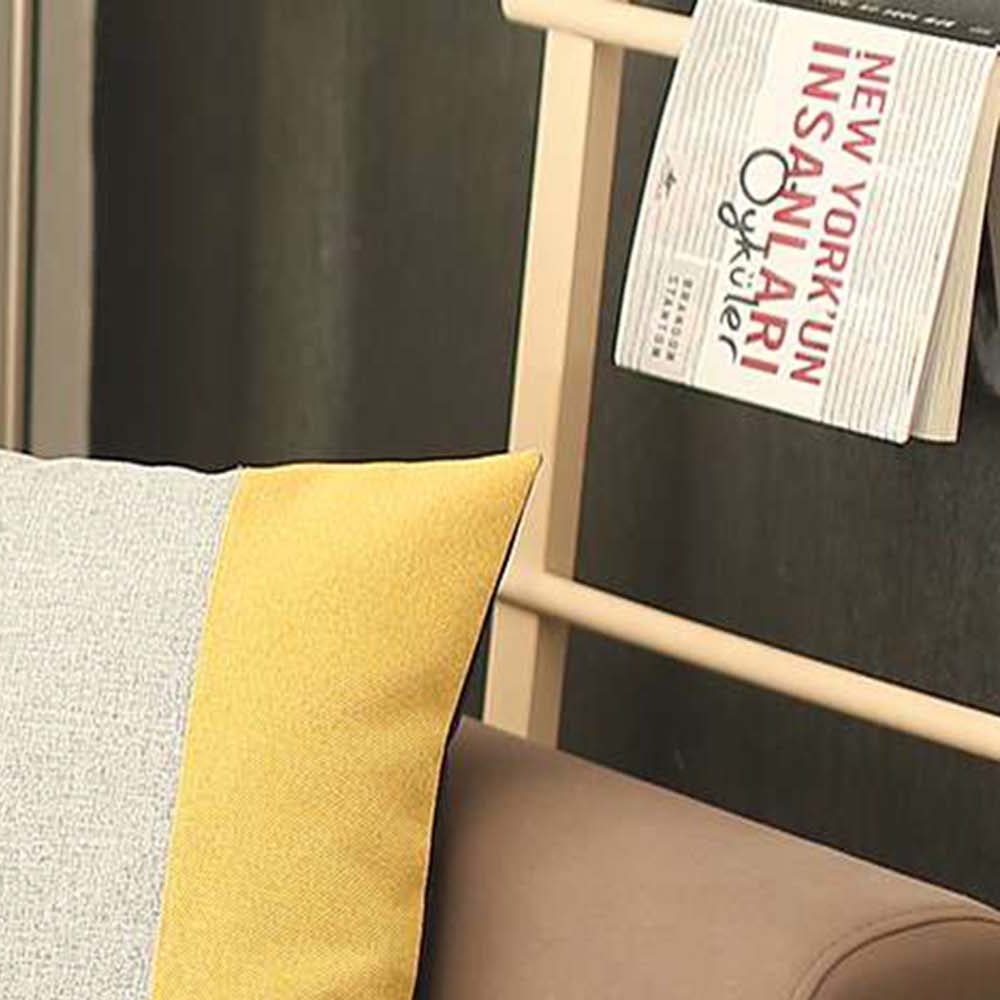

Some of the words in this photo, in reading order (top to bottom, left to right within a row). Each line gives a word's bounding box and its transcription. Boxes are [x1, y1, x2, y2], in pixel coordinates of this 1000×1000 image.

[740, 41, 862, 374] İNSANLARI
[841, 51, 896, 163] NEW
[789, 181, 867, 386] YORK'UN
